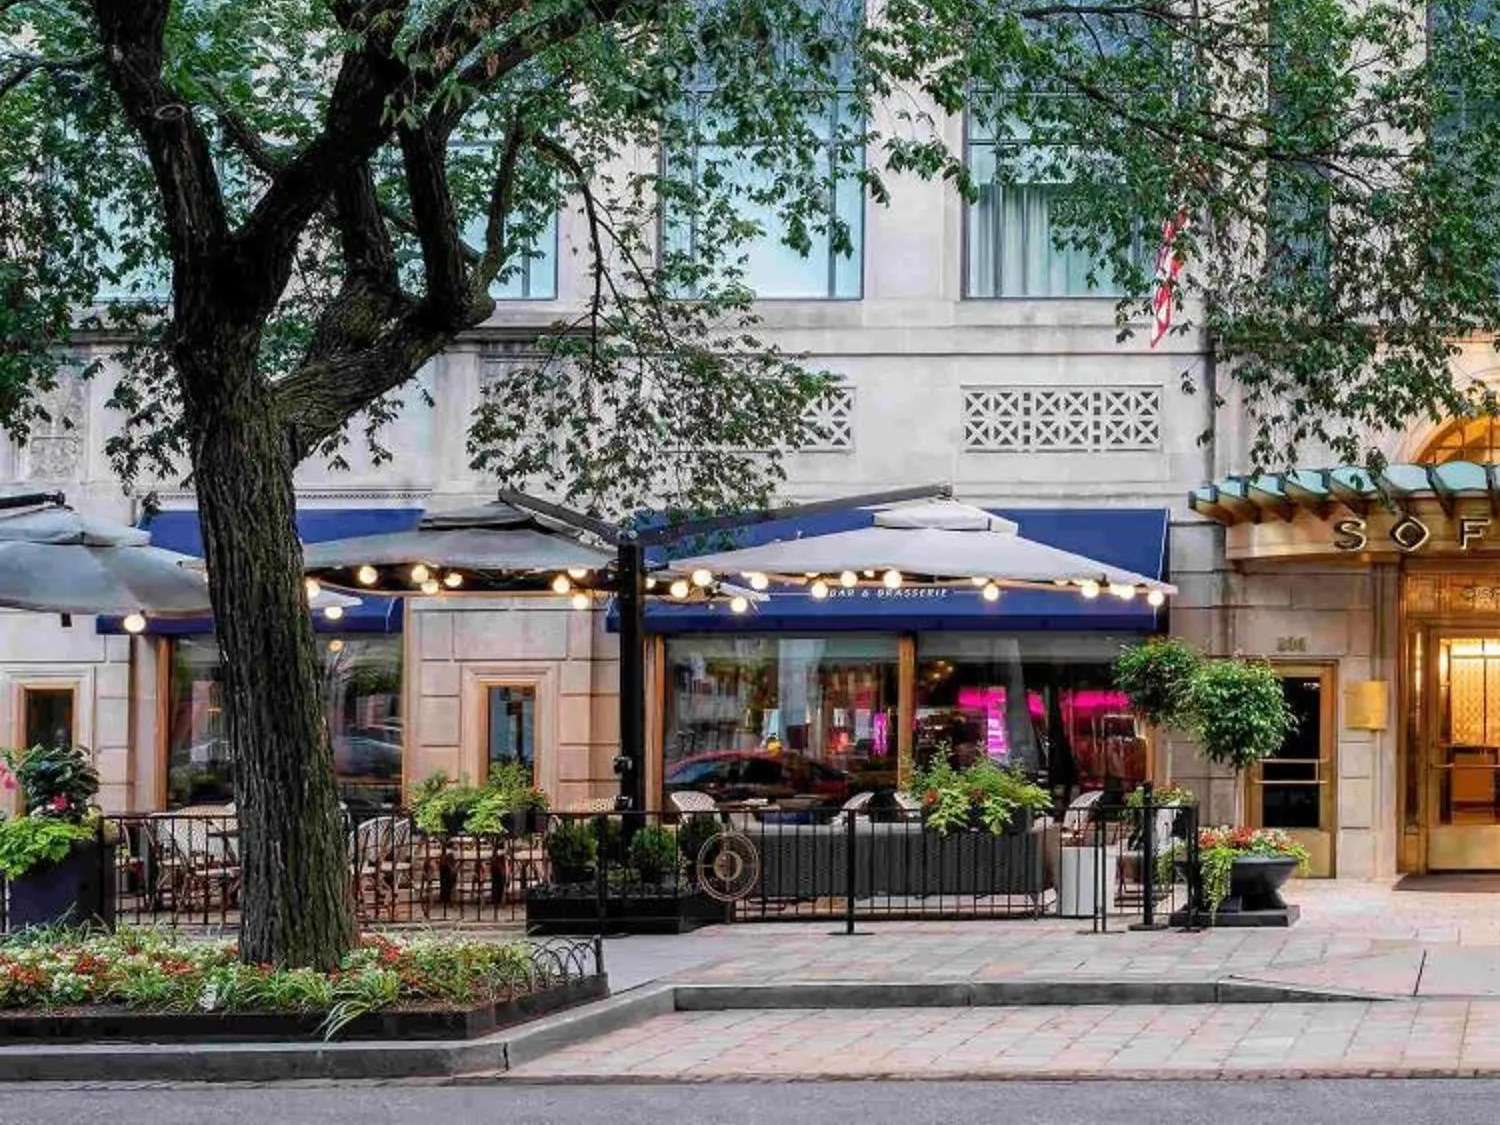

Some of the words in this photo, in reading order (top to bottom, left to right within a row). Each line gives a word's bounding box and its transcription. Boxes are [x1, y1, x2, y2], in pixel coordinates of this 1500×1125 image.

[829, 588, 855, 598] BAR
[861, 588, 870, 598] &
[877, 588, 948, 598] BRASSERIE
